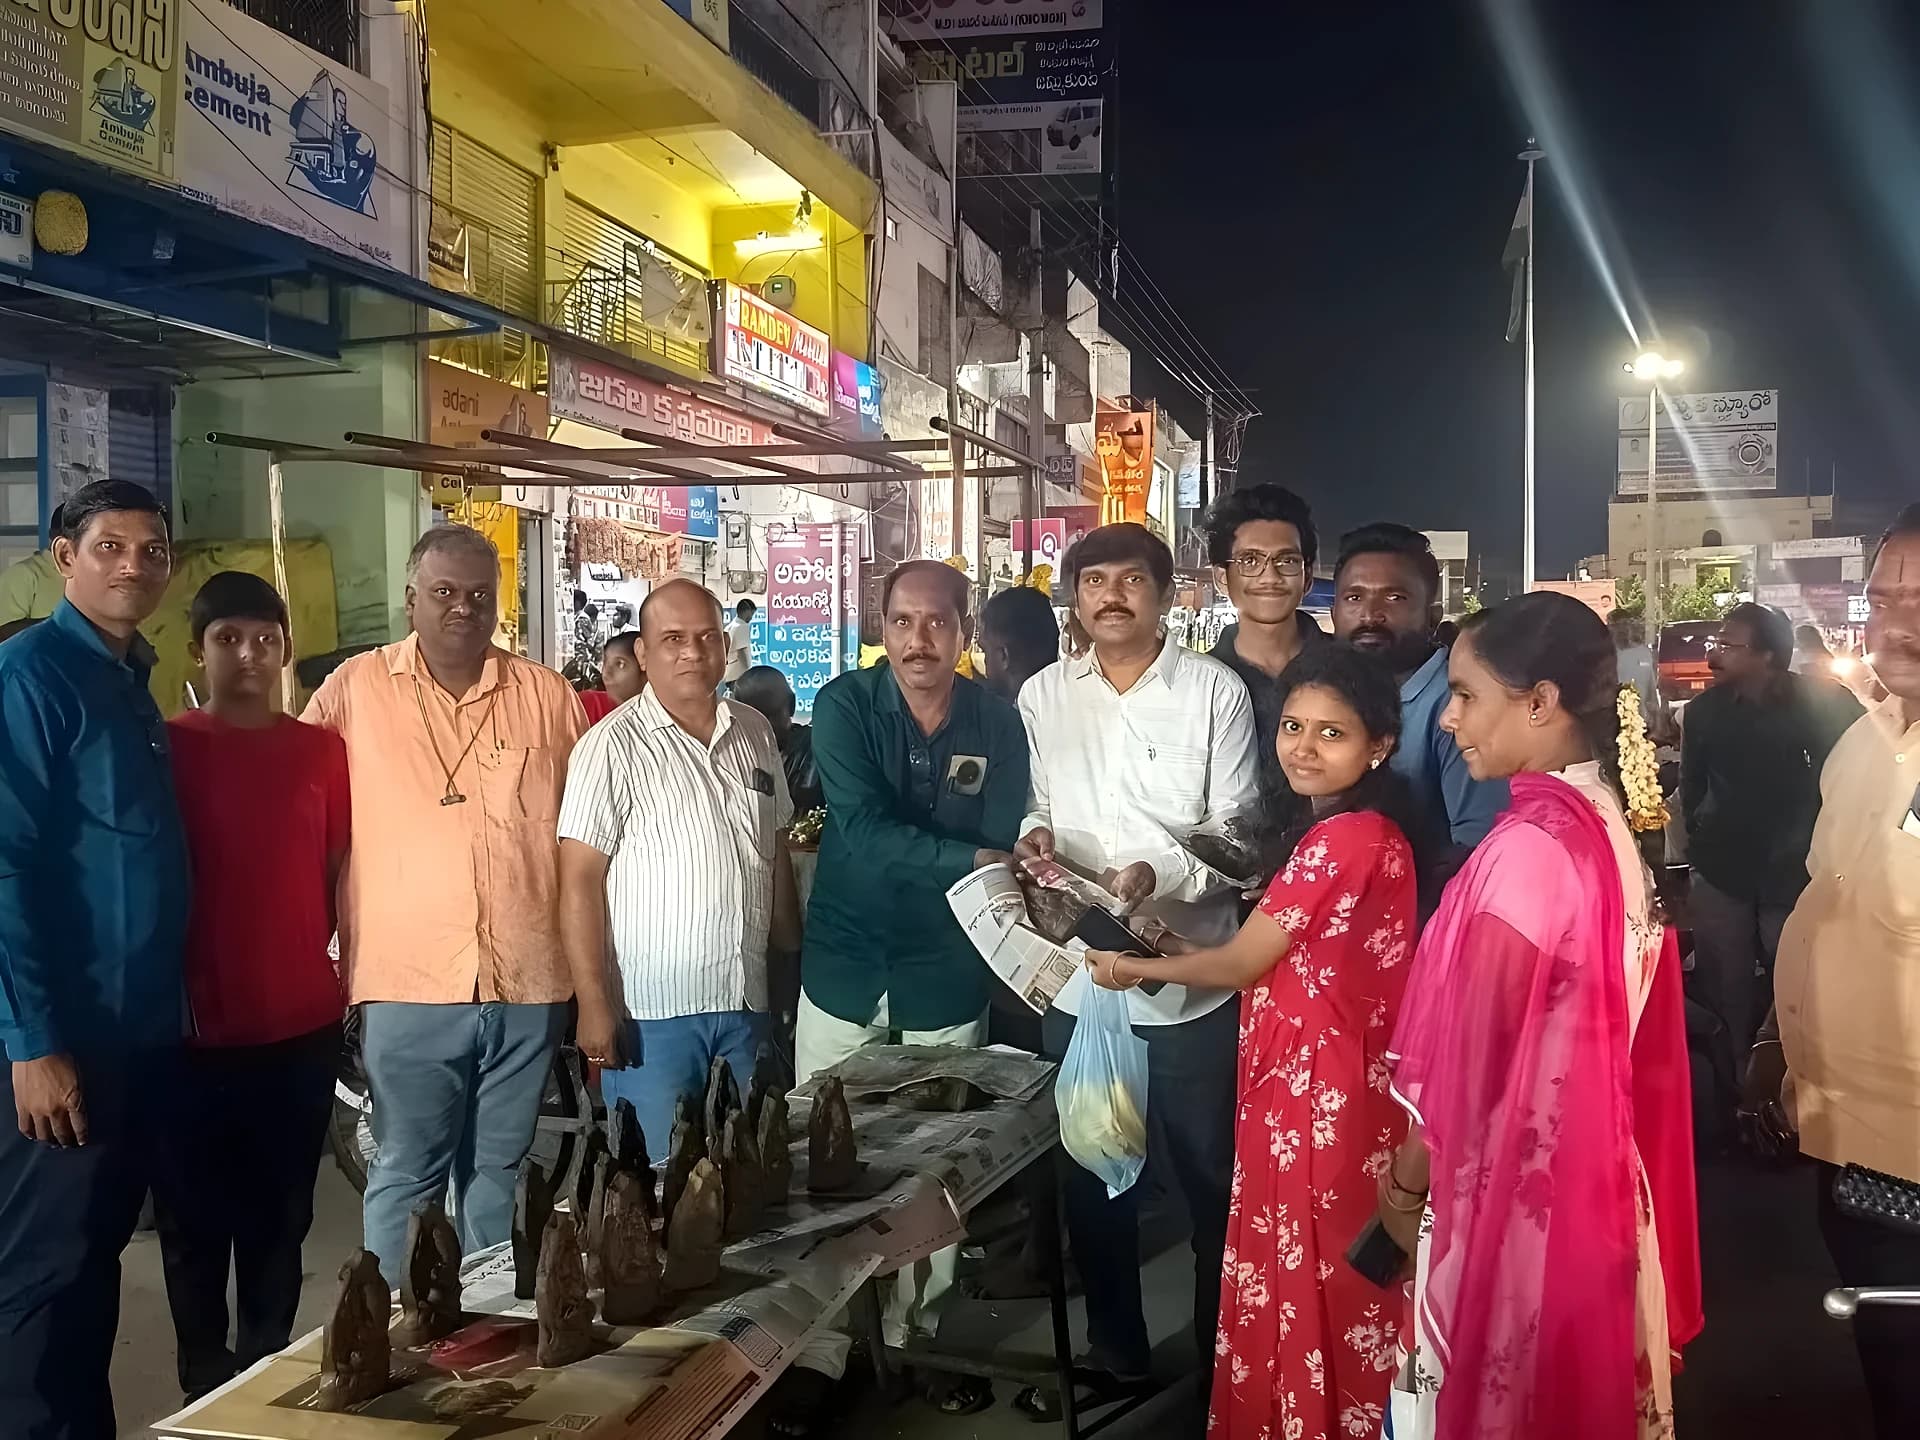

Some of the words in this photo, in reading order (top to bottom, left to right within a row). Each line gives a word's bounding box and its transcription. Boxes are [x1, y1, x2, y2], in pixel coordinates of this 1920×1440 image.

[101, 119, 145, 144] Ambuja
[740, 299, 792, 349] RAMDEV
[442, 387, 479, 416] adani
